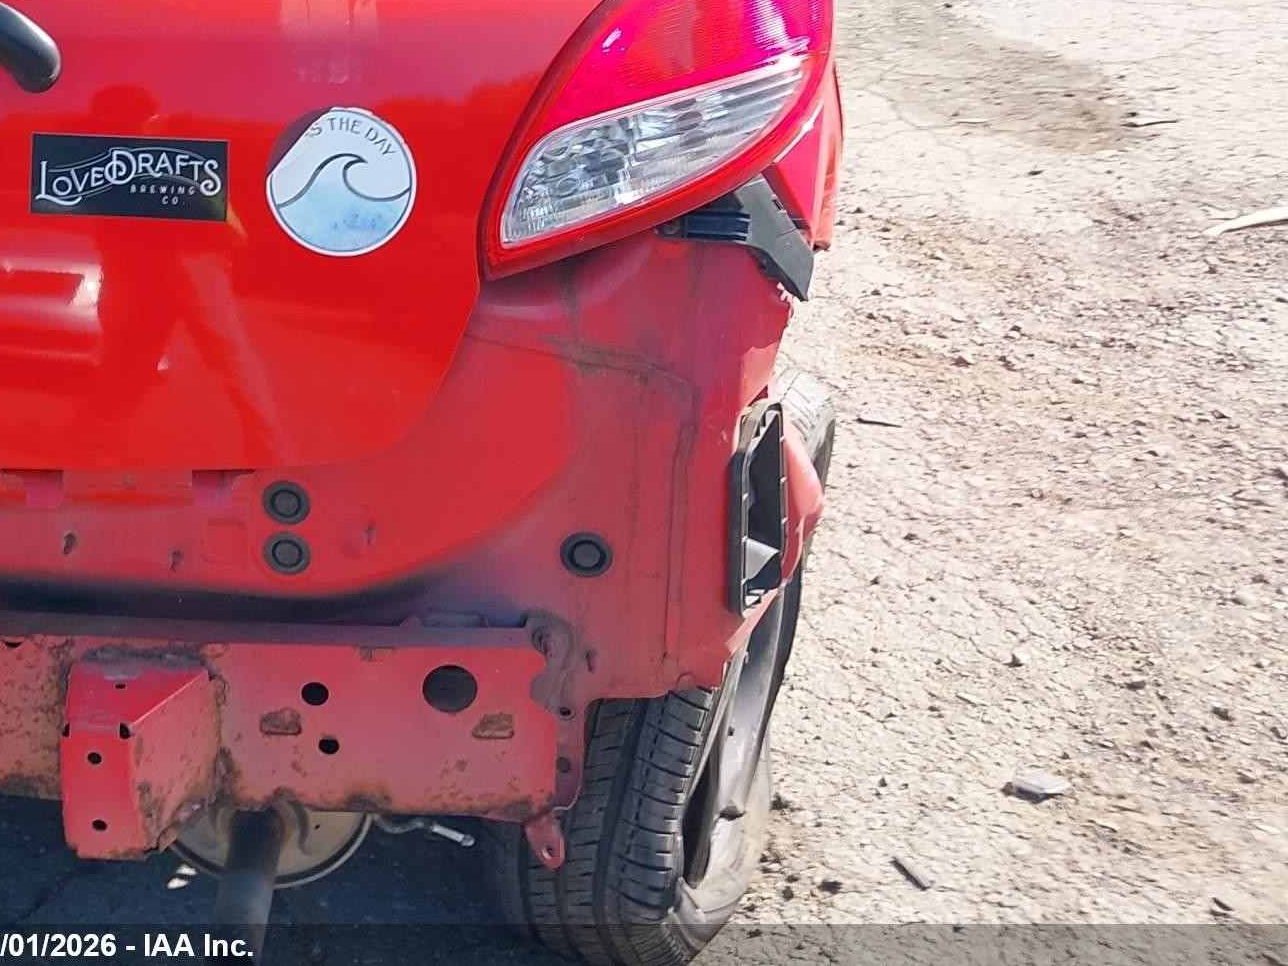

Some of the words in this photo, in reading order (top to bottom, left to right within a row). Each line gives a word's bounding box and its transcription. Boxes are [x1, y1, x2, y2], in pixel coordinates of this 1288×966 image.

[326, 116, 362, 135] THE
[364, 126, 397, 157] DAY
[129, 185, 196, 196] BREWING
